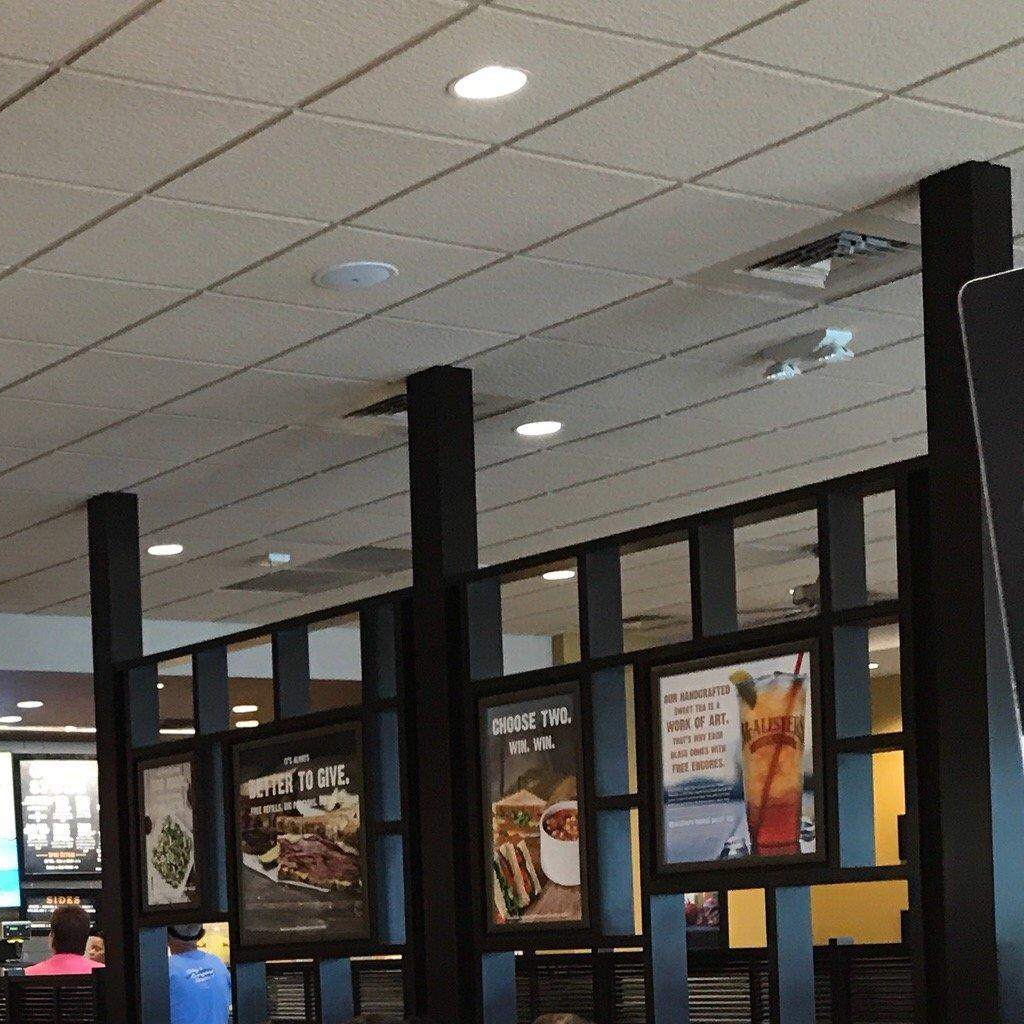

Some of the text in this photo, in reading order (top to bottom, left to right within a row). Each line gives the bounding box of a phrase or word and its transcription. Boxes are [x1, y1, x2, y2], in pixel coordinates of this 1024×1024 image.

[680, 685, 730, 701] HANDCRAFTED
[492, 707, 571, 735] CHOOSE TWO.
[667, 712, 729, 732] WORK OF ART.
[508, 735, 555, 755] WIN. WIN.
[298, 770, 314, 791] TO
[317, 764, 350, 789] GIVE.
[672, 762, 689, 773] FREE
[46, 895, 81, 905] SIDES
